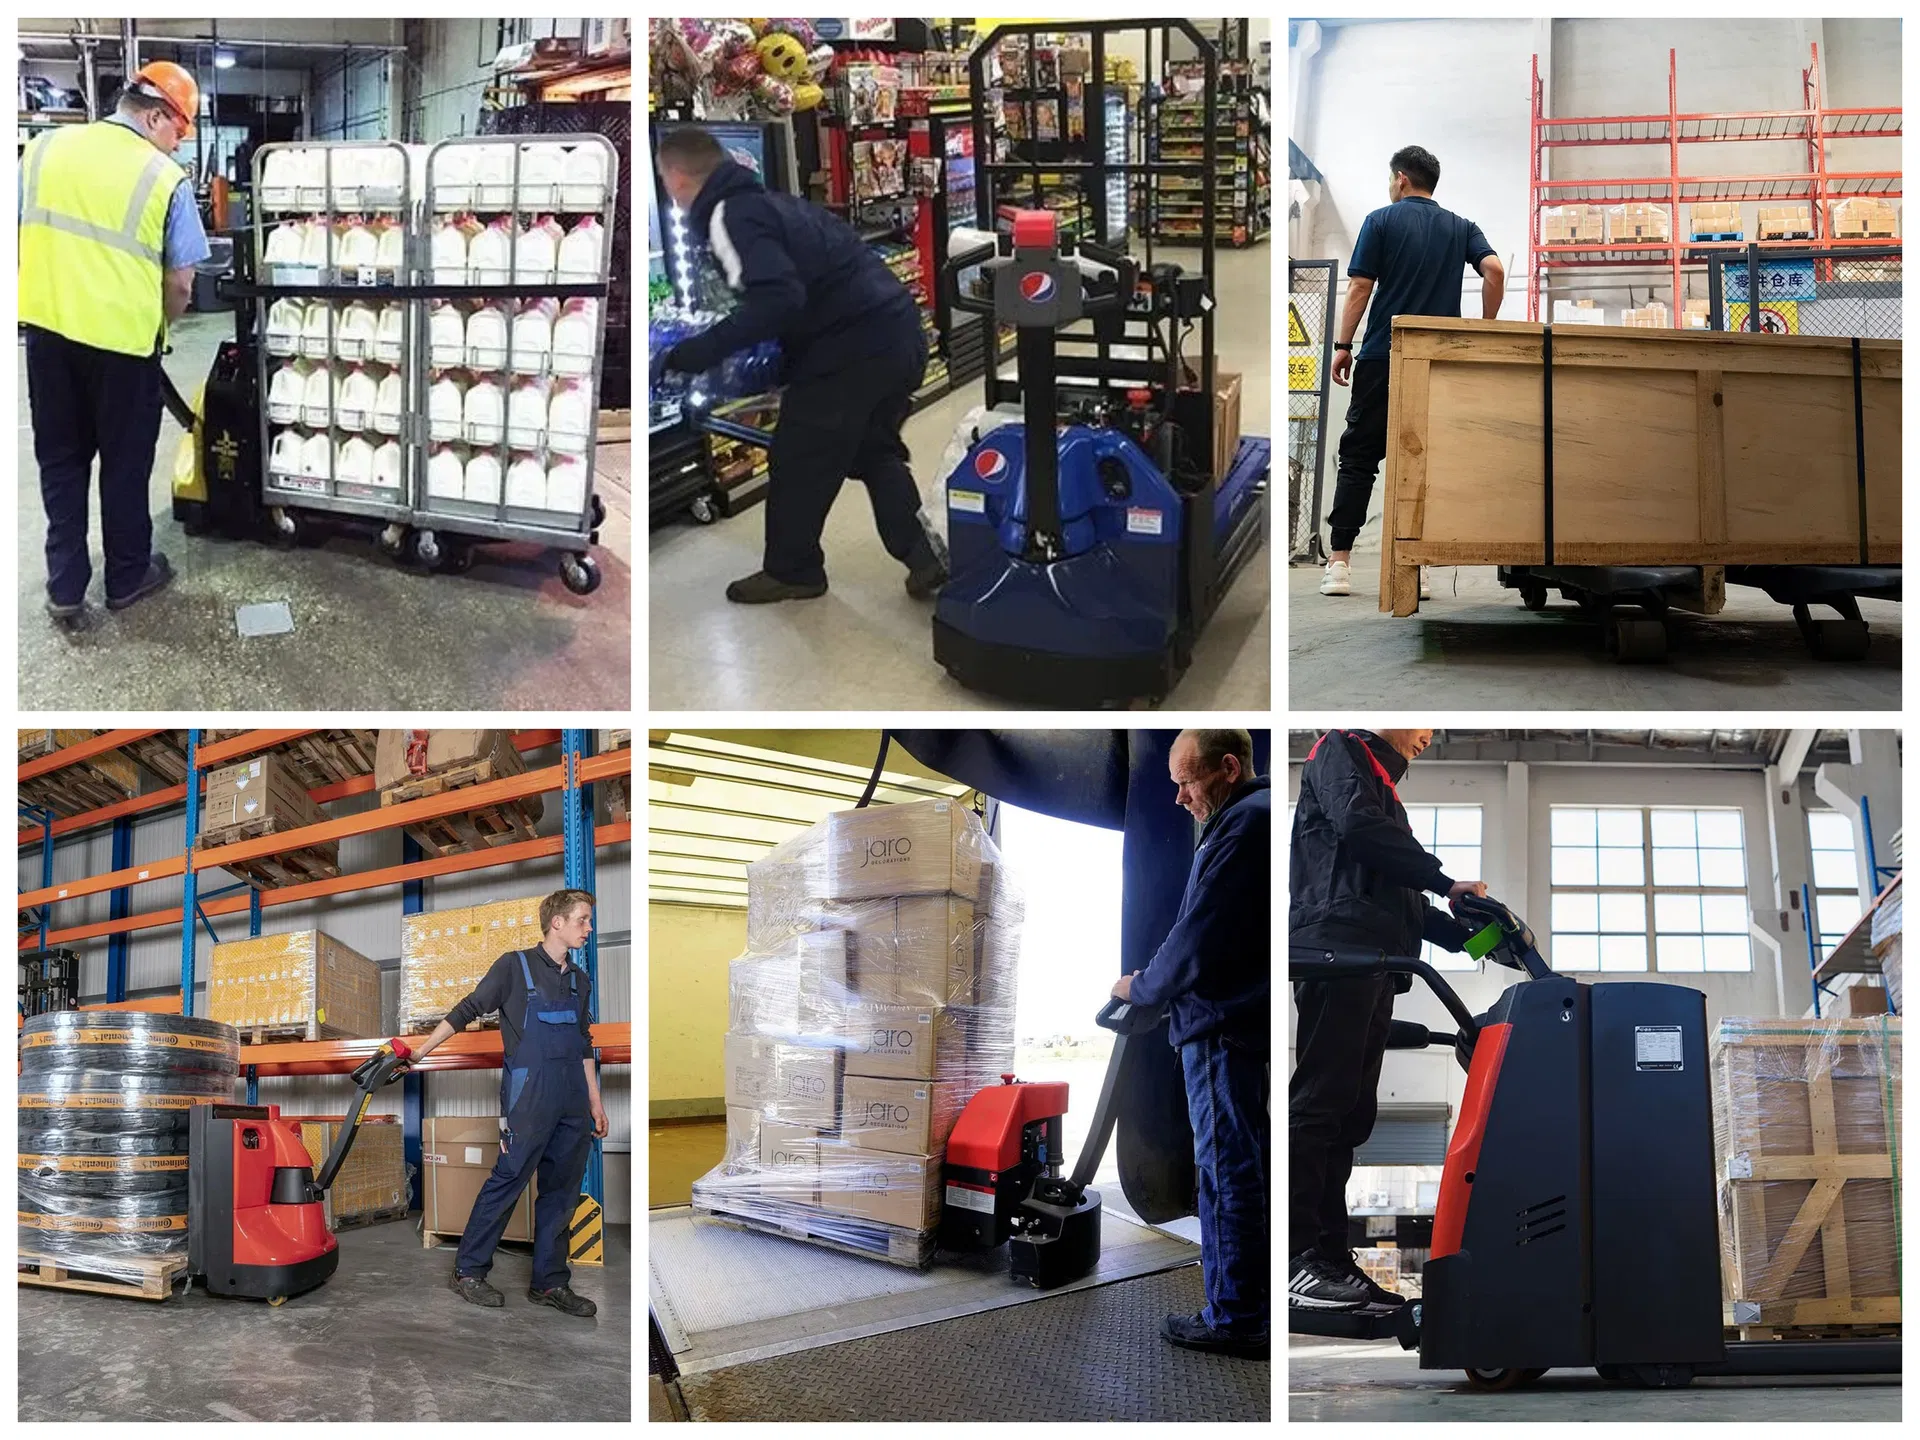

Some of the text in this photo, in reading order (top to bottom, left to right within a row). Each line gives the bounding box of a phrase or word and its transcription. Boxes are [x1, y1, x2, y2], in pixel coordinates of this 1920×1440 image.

[860, 836, 912, 868] jaro
[863, 1028, 913, 1055] jaro
[783, 1073, 826, 1098] jaro
[859, 1101, 910, 1127] jaro
[870, 1121, 908, 1130] DECORATIONS
